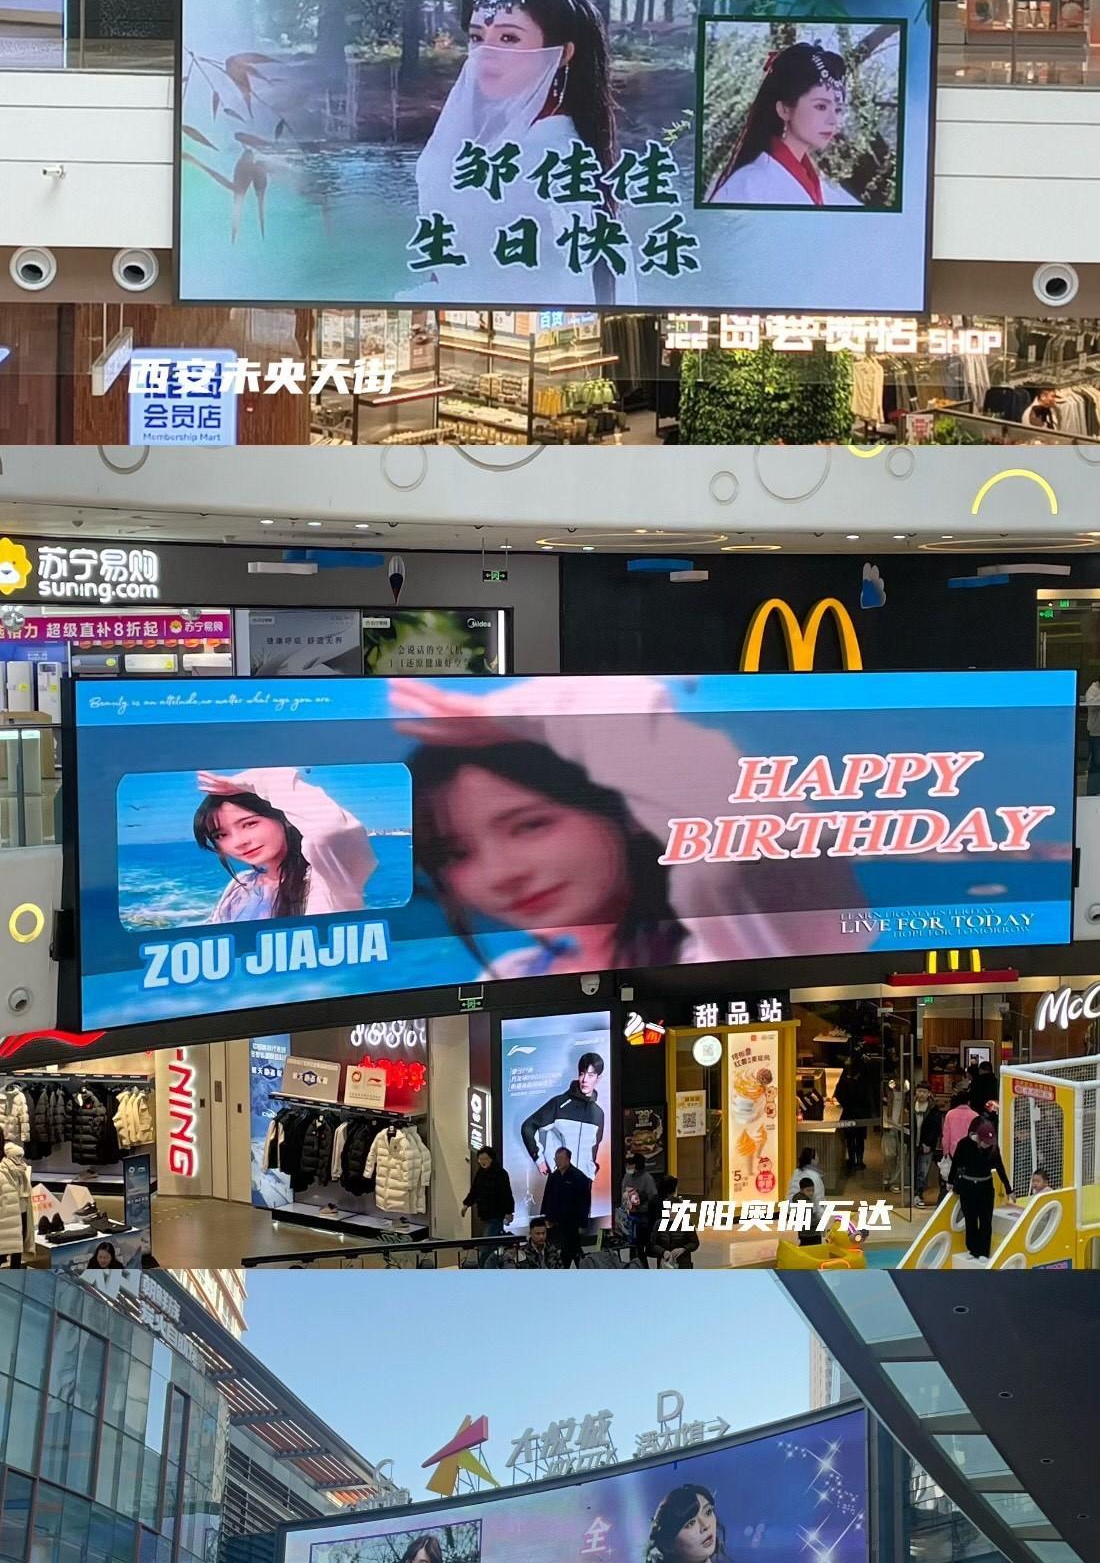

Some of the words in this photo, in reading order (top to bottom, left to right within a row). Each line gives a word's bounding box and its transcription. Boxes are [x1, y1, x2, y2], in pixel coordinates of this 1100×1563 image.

[451, 139, 680, 206] 邹佳佳
[406, 211, 700, 278] 生日快乐
[928, 329, 1002, 354] SHOP
[143, 403, 222, 429] 会员店
[142, 432, 198, 442] Membership
[199, 432, 222, 441] Mart
[37, 546, 159, 583] 苏宁易购
[37, 580, 159, 604] suning.com
[46, 621, 159, 639] 超级直补8折起
[184, 621, 224, 633] 苏宁易购
[728, 750, 985, 804] HAPPY
[658, 806, 1056, 866] BIRTHDAY
[840, 911, 881, 920] LEARN
[840, 919, 892, 934] LIVE
[897, 916, 945, 930] FOR
[951, 913, 1035, 928] TODAY
[143, 937, 231, 989] ZOU
[245, 922, 389, 975] JIAJIA
[693, 997, 783, 1028] 甜品站
[656, 1389, 685, 1423] D
[505, 1408, 615, 1468] 大悦城
[634, 1420, 706, 1459] 活力馆
